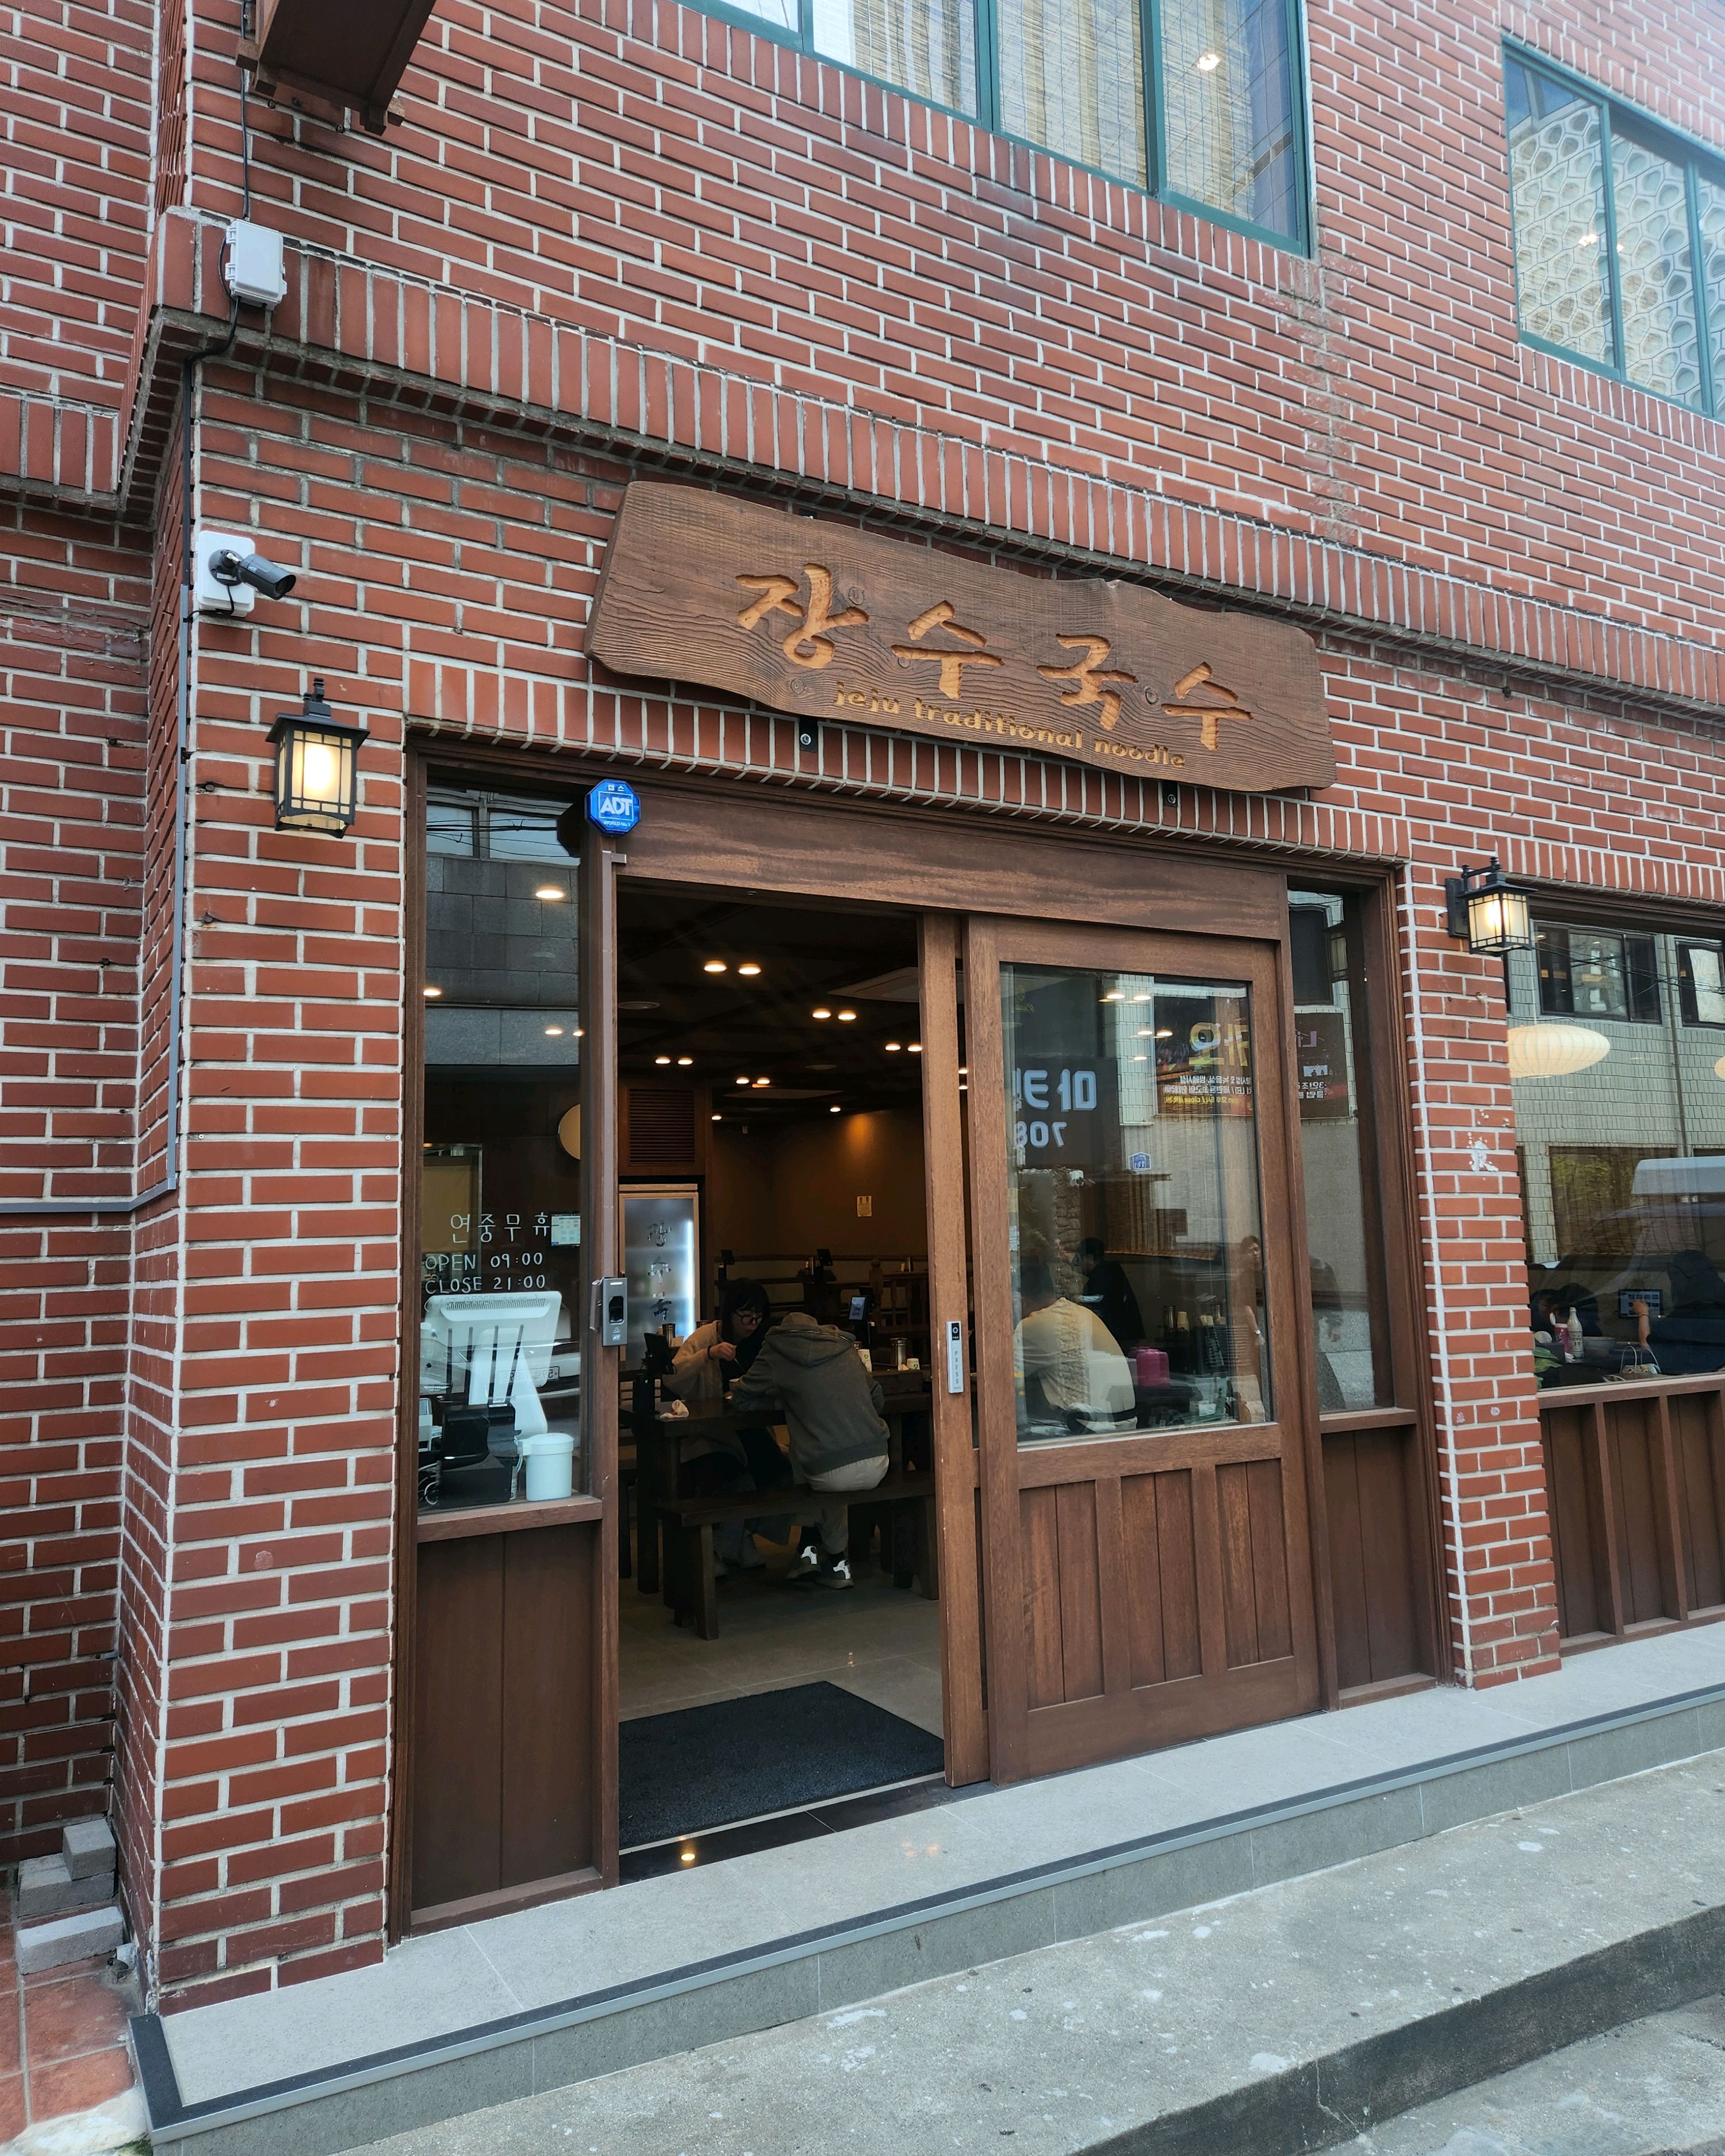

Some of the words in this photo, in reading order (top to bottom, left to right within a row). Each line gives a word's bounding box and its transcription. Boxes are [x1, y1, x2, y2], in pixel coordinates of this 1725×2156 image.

[735, 562, 1254, 751] 장수국수
[833, 681, 900, 714] jeju
[913, 697, 1083, 748] traditional
[1094, 738, 1186, 768] noodle
[599, 796, 633, 816] ADT
[451, 1212, 550, 1243] 연중무휴
[425, 1254, 476, 1271] OPEN
[490, 1252, 543, 1269] 09:00
[425, 1276, 482, 1294] CLOSE
[493, 1275, 546, 1290] 21:00
